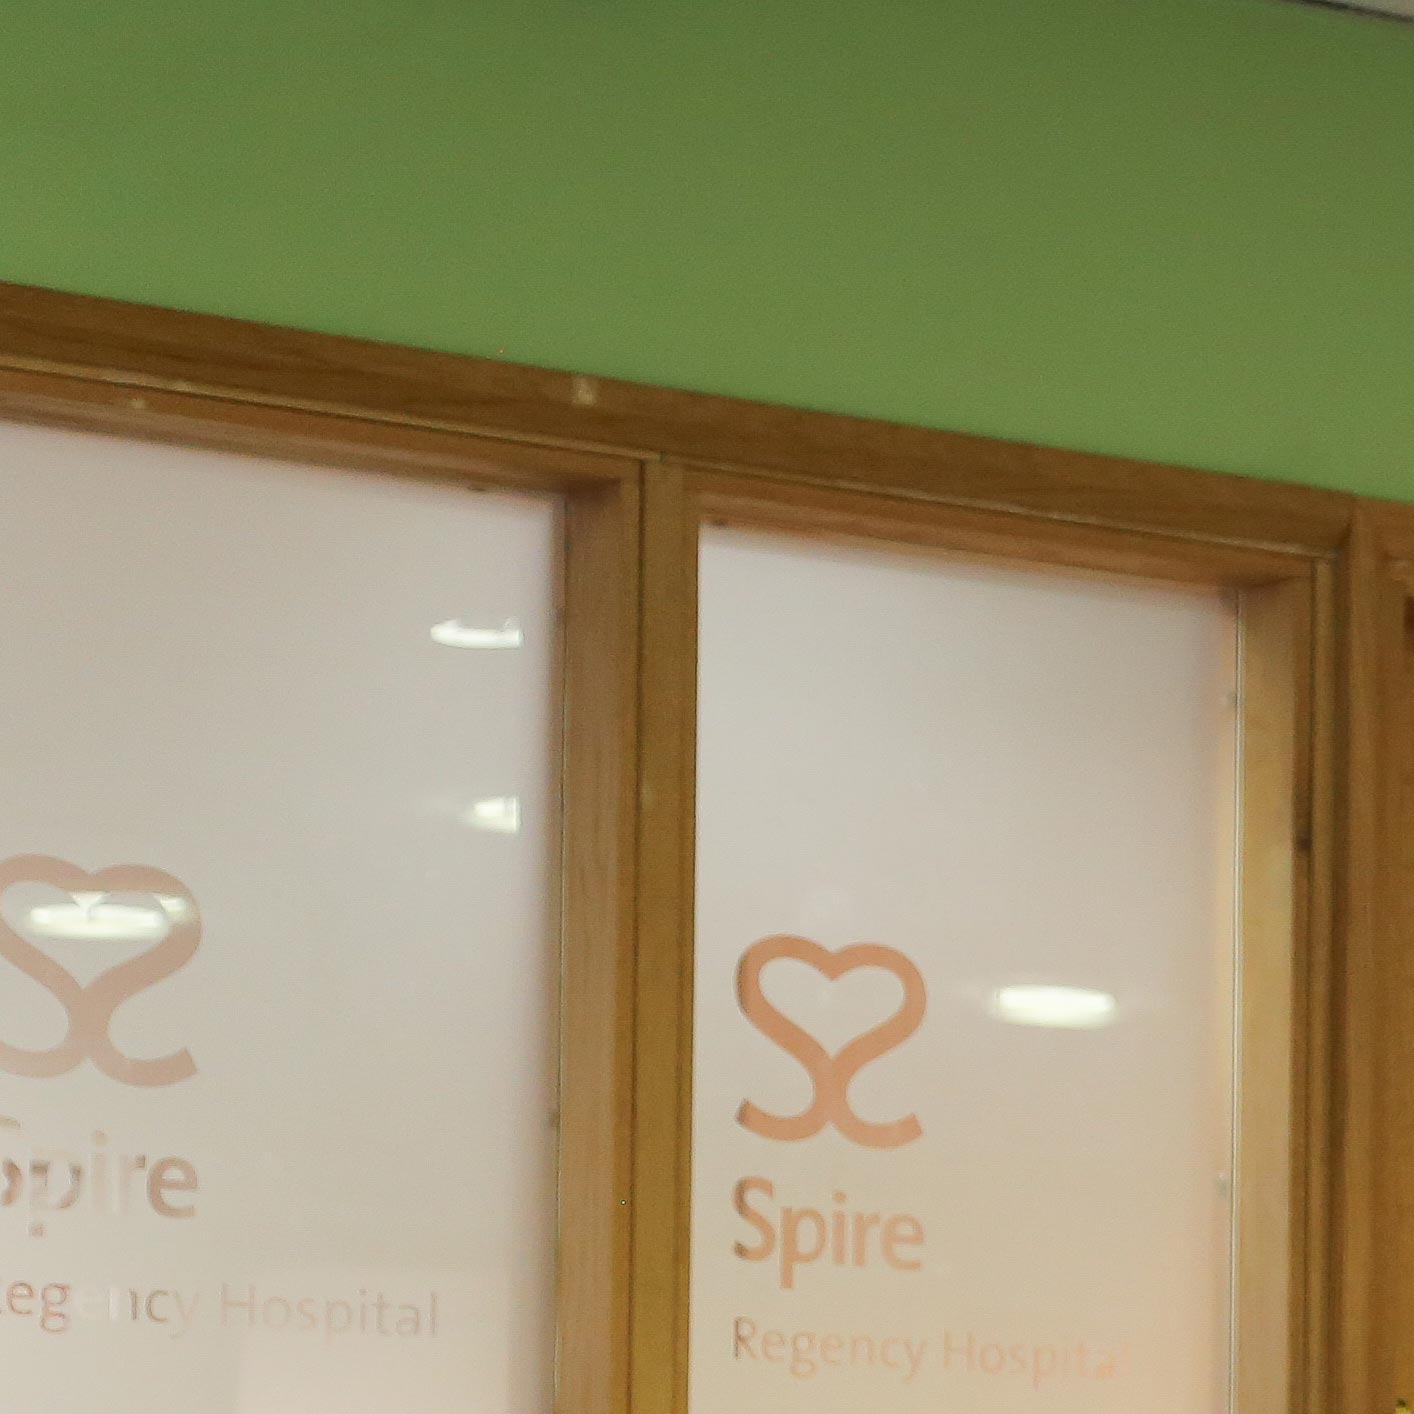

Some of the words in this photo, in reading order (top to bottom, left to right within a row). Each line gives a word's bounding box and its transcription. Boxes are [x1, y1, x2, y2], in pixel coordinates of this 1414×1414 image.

[731, 1175, 924, 1289] Spire
[0, 1279, 197, 1339] egency
[220, 1282, 440, 1346] Hospital
[732, 1315, 929, 1384] Regency
